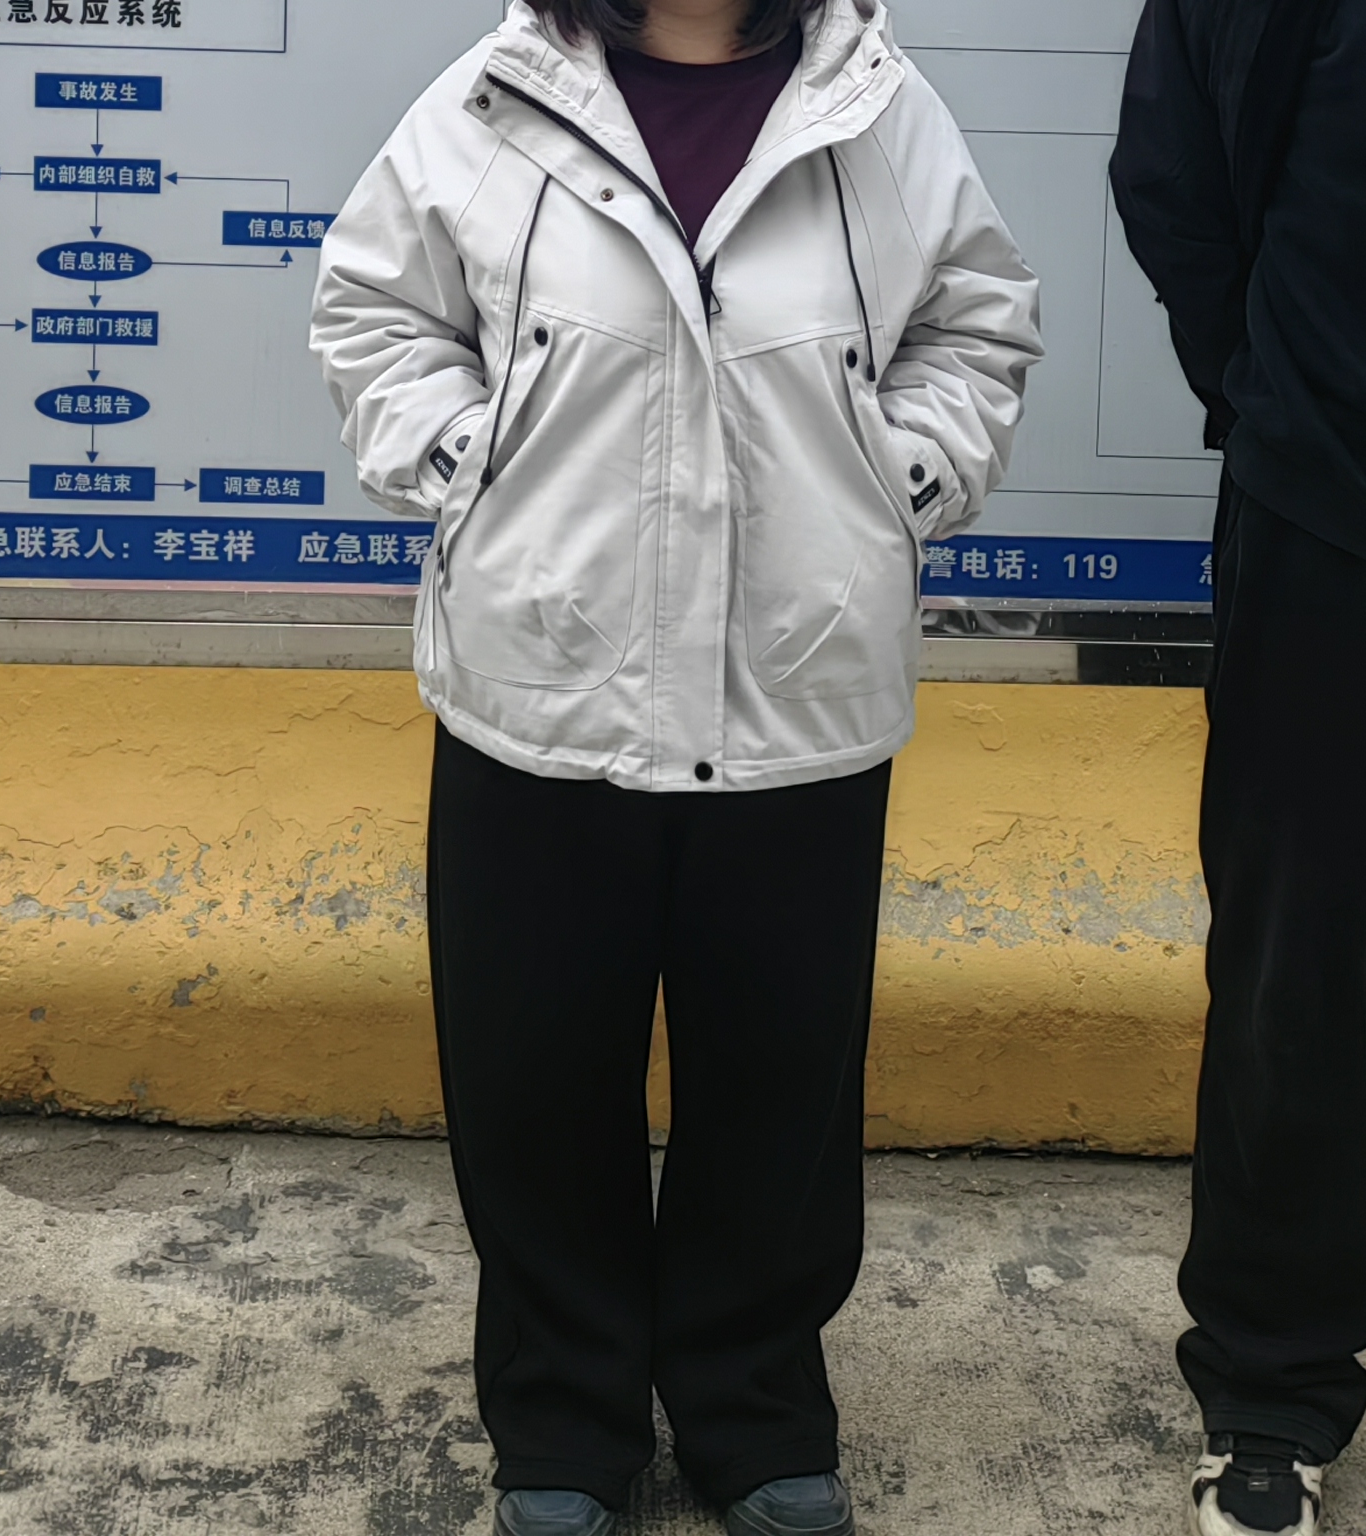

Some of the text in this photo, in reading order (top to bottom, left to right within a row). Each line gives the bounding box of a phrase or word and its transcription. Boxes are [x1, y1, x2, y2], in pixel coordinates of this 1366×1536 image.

[58, 80, 138, 103] 事故发生
[39, 164, 156, 187] 内部组织自救
[247, 217, 325, 240] 信息反馈
[57, 250, 136, 273] 信息报告
[36, 315, 154, 338] 政府部门救援
[54, 393, 132, 415] 信息报告
[54, 471, 132, 494] 应急结束
[223, 475, 302, 498] 调查总结
